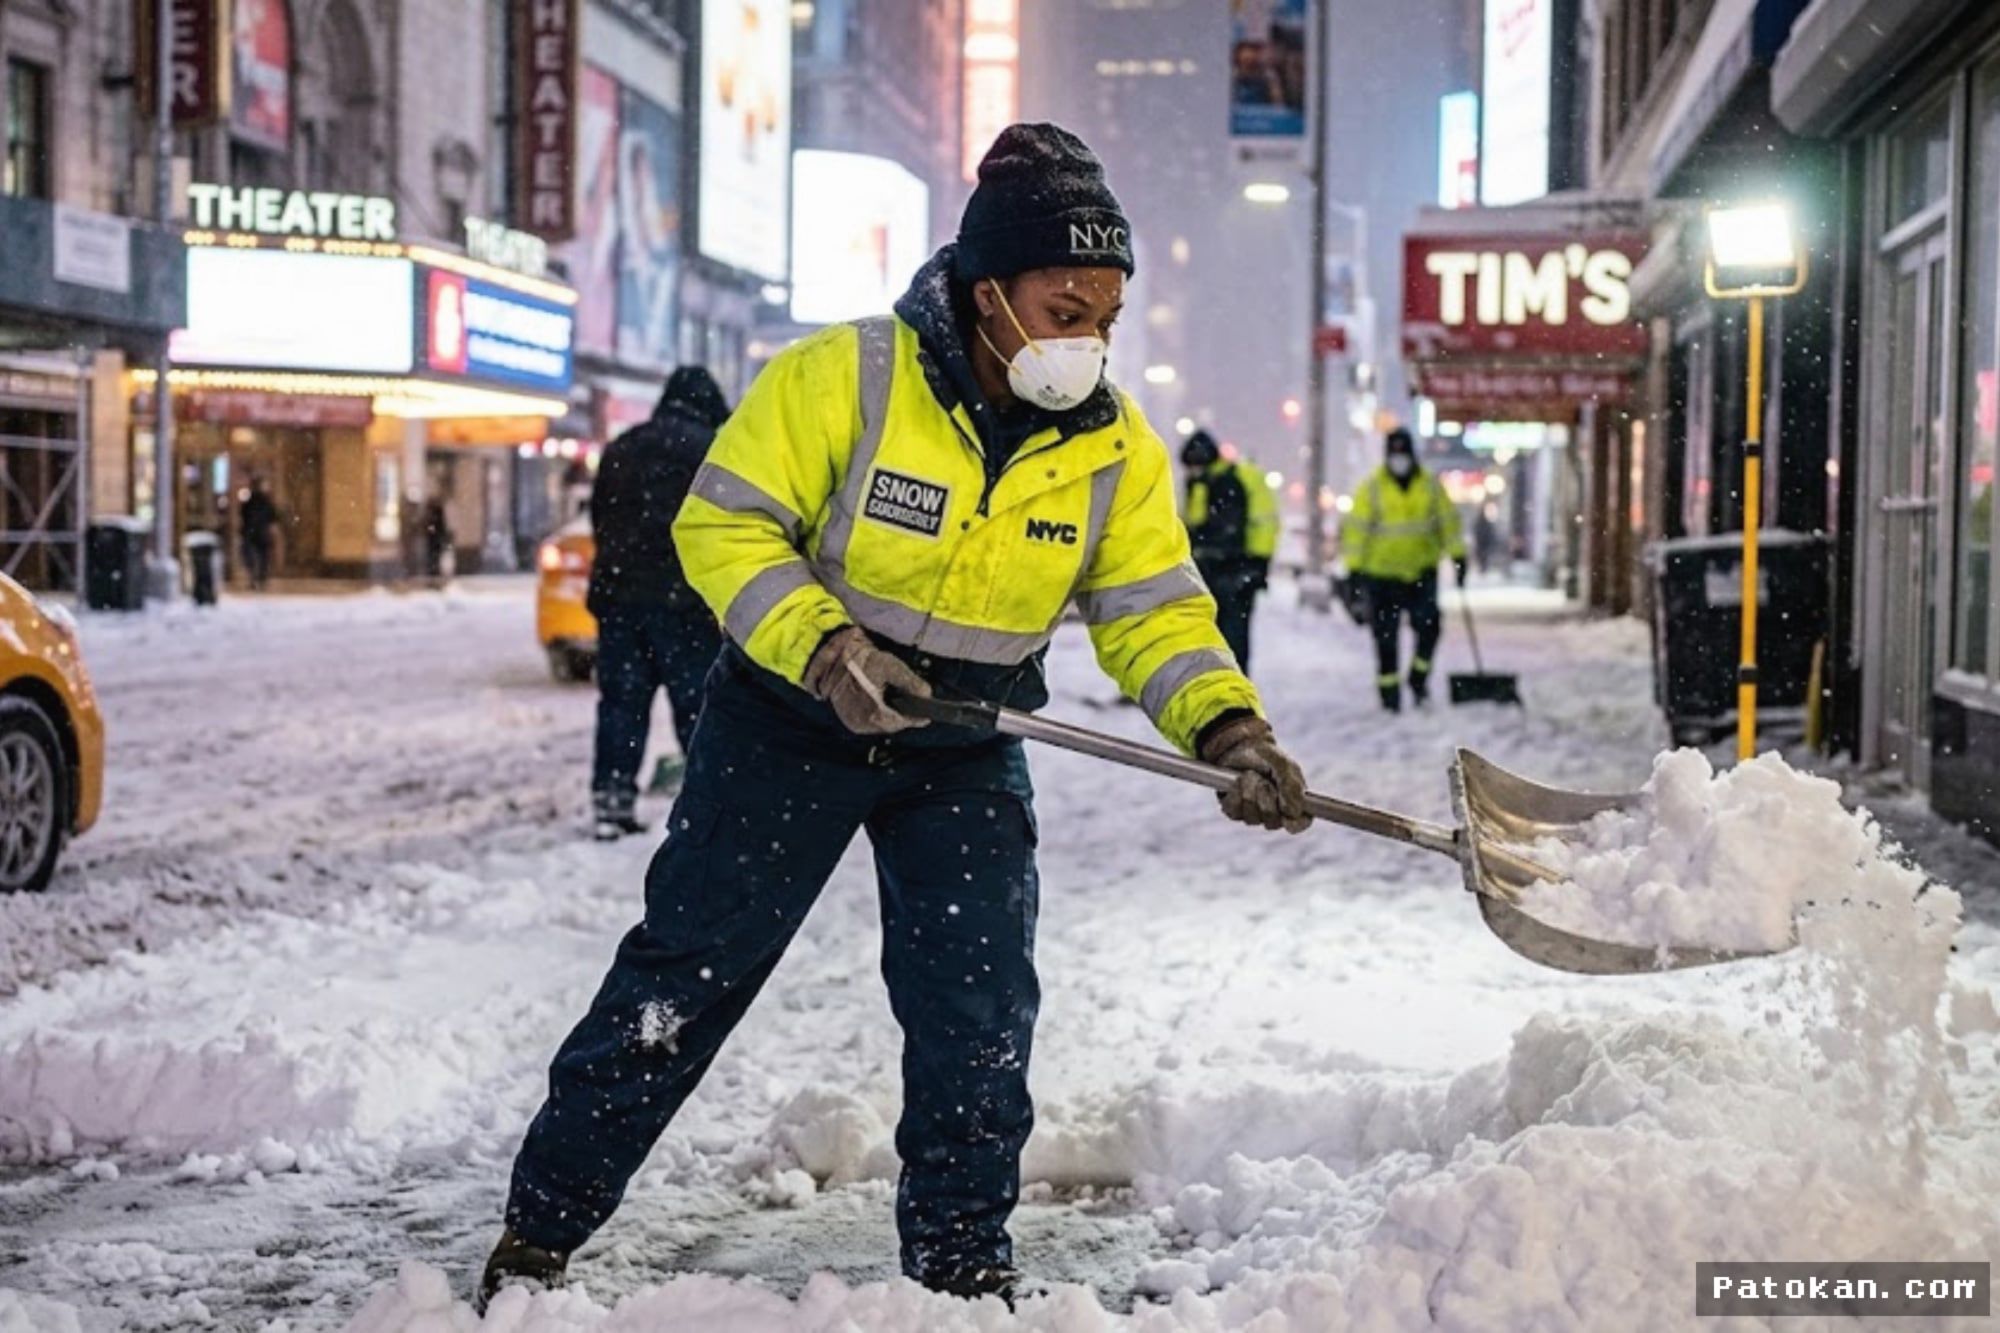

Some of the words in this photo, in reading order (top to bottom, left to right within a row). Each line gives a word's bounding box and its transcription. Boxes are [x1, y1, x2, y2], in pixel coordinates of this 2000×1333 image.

[187, 183, 396, 239] THEATER
[1069, 223, 1127, 249] NYC
[1426, 243, 1633, 326] TIM'S
[873, 475, 943, 514] SNOW
[1026, 518, 1077, 545] NYC
